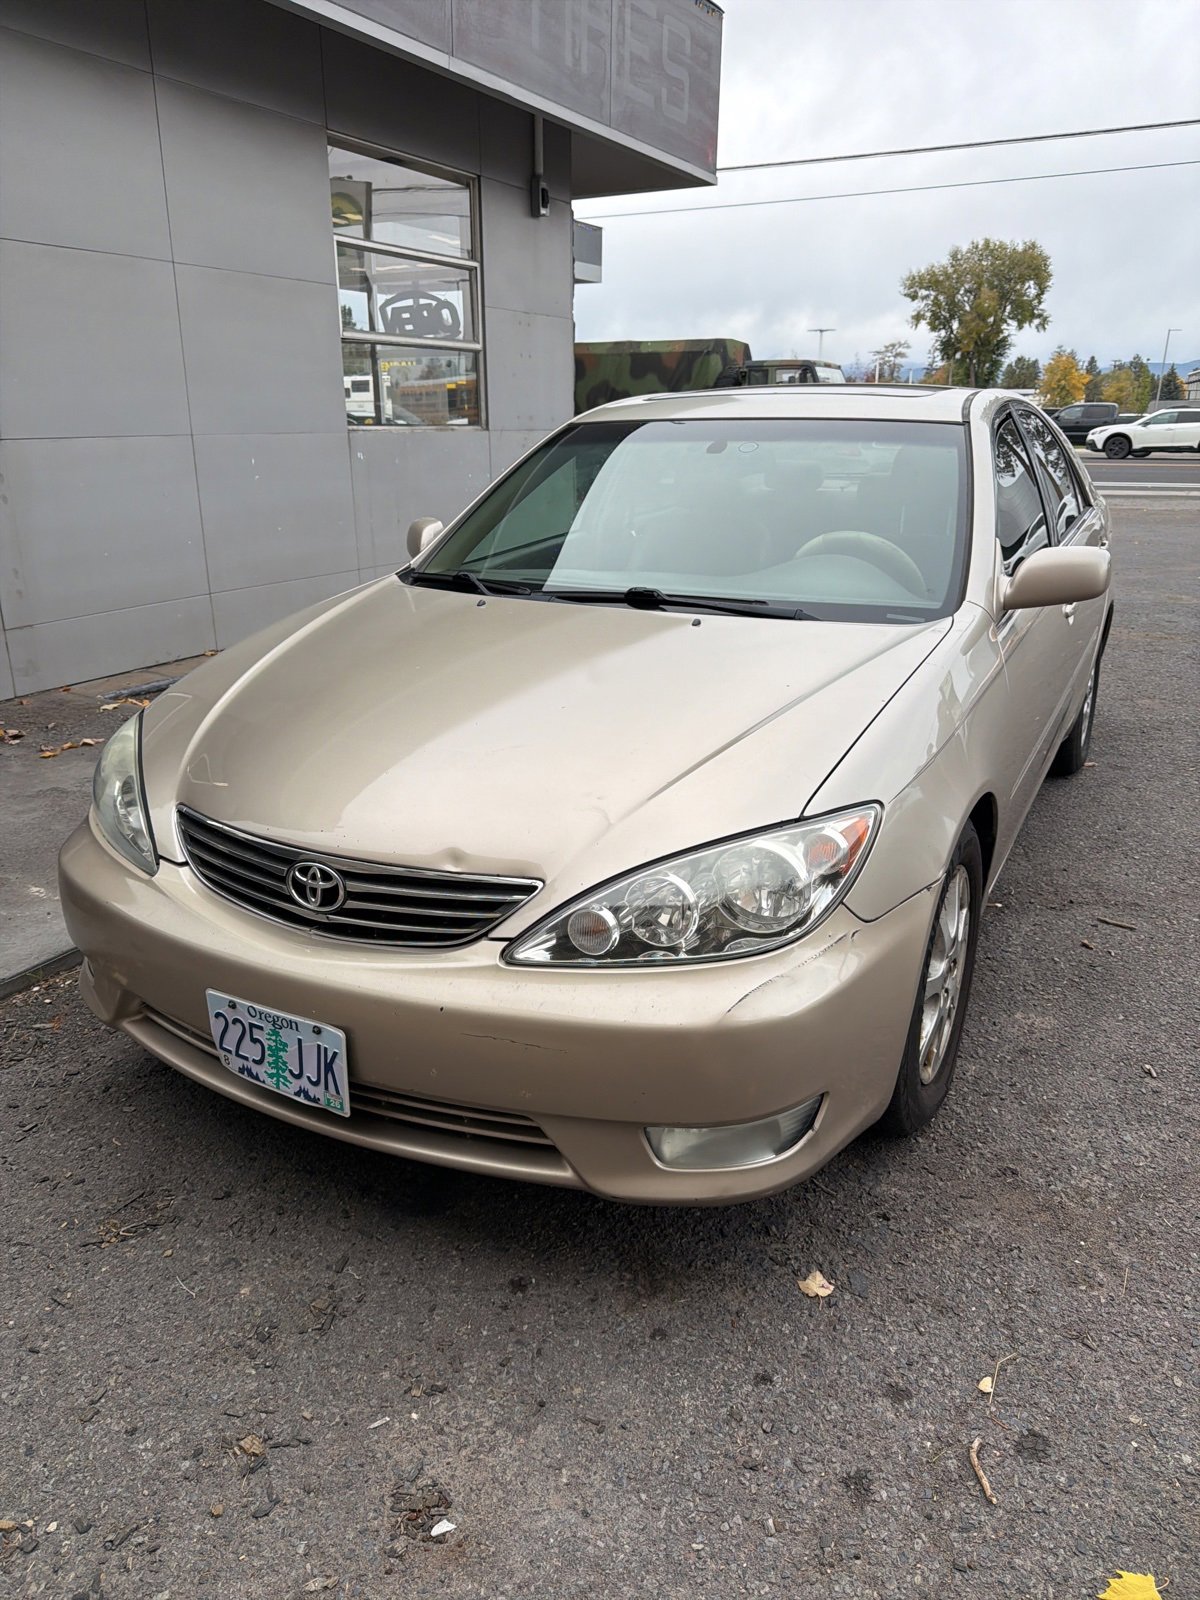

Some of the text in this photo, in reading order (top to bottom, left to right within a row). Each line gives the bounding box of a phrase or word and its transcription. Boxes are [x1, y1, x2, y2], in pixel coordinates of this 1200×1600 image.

[247, 1005, 301, 1032] Oregon
[214, 1011, 341, 1096] 225 JJK
